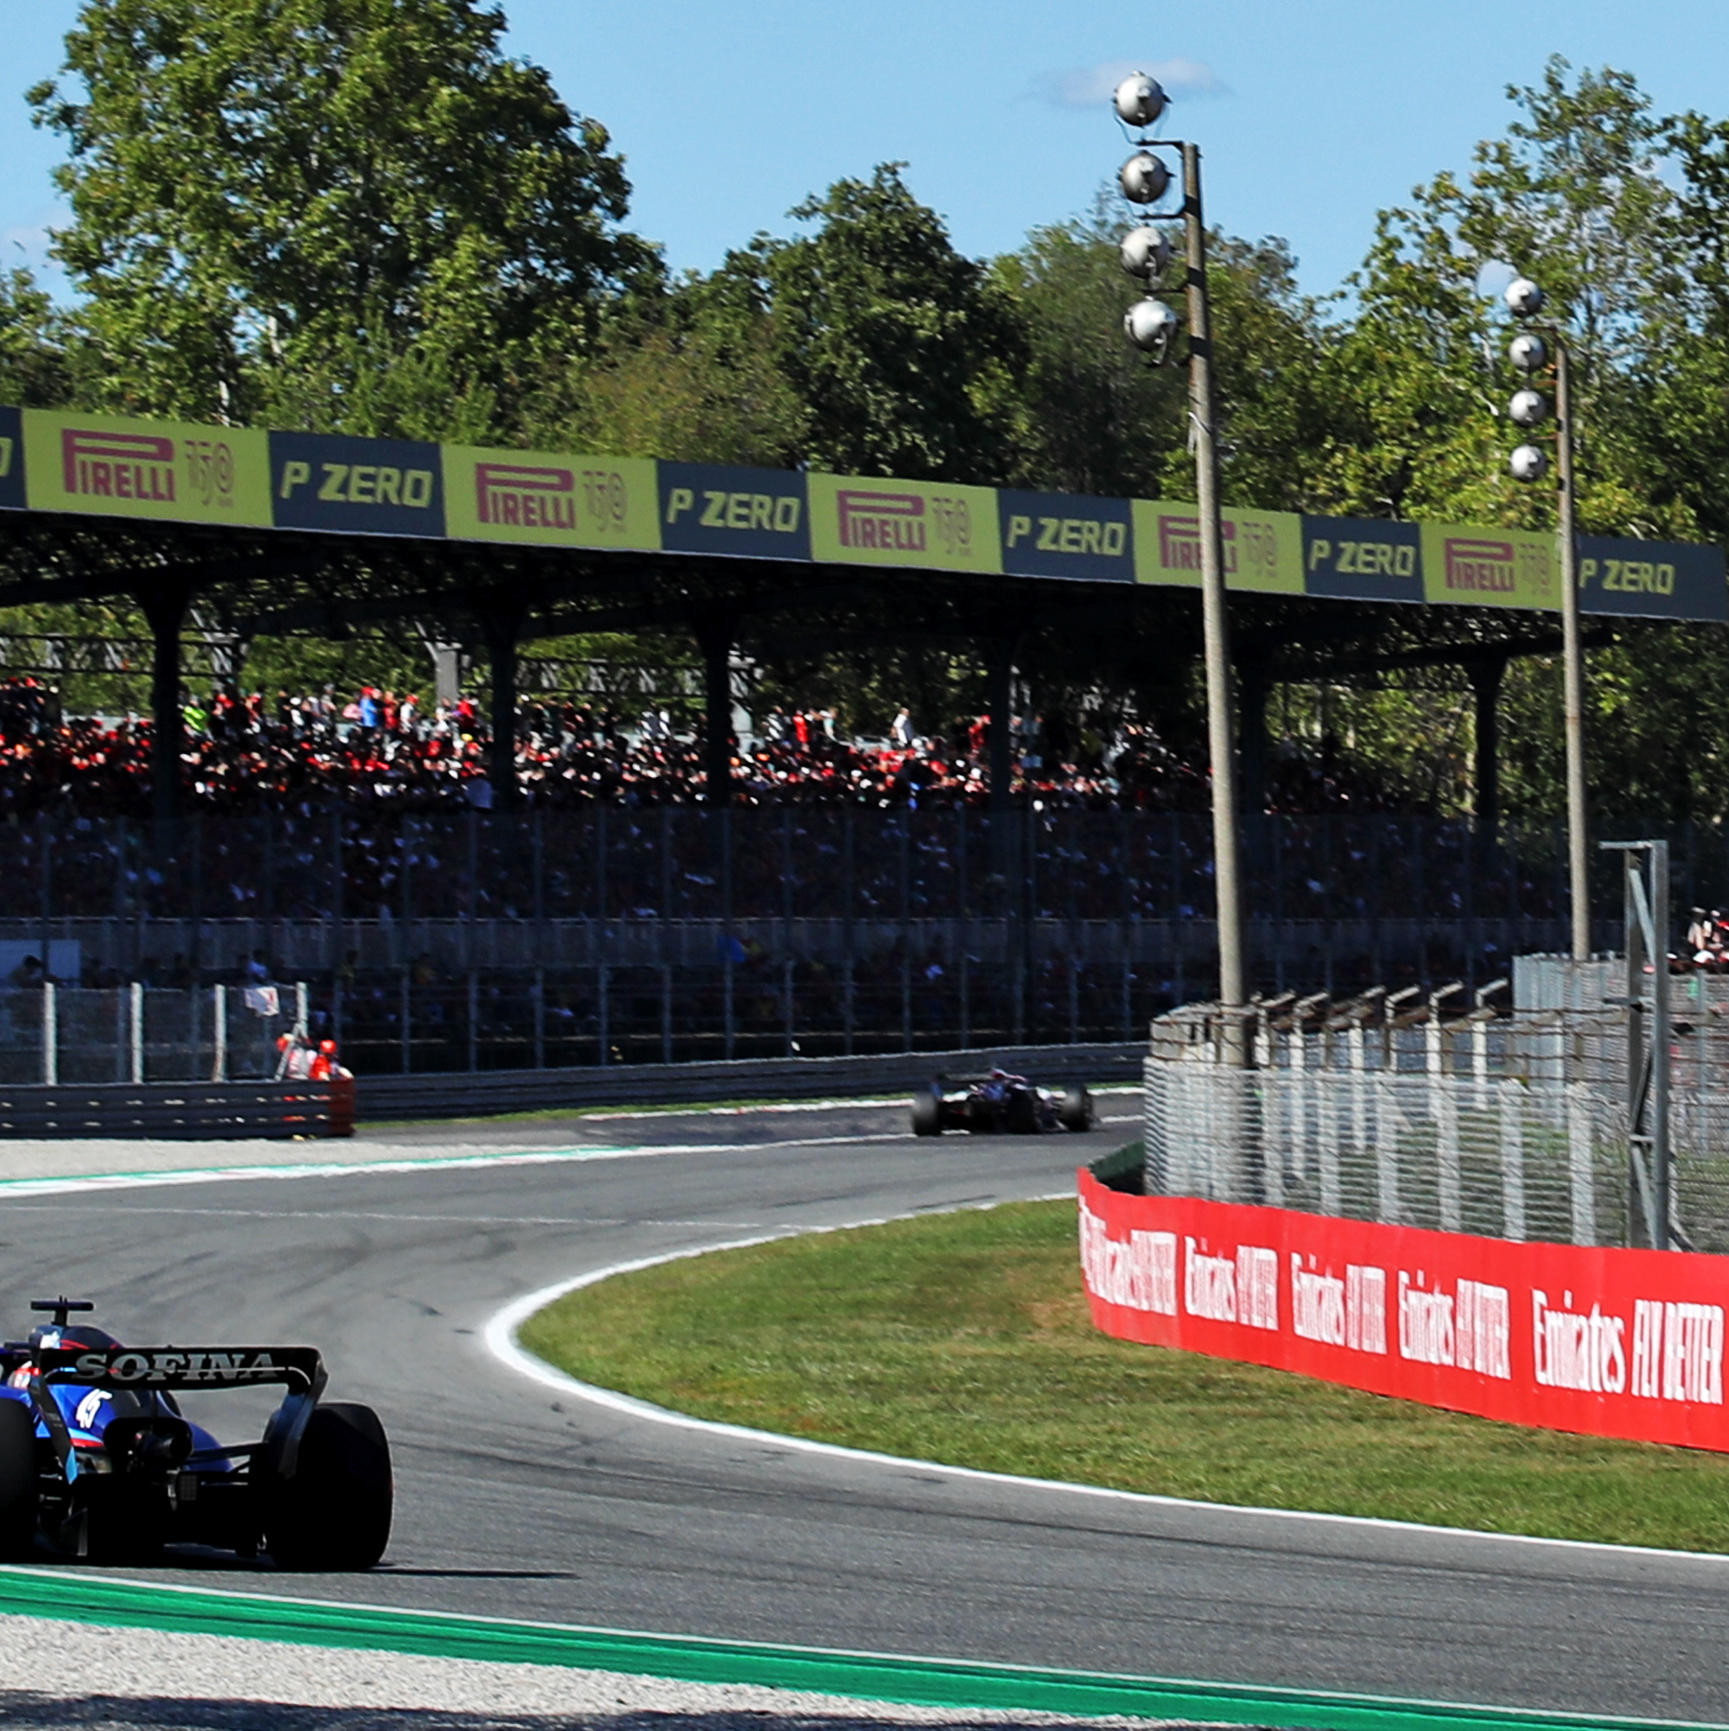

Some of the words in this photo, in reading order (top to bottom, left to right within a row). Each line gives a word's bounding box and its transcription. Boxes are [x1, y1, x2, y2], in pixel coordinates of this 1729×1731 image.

[61, 428, 177, 502] PIRELLI
[279, 460, 311, 500] P
[317, 463, 434, 509] ZERO
[475, 462, 577, 529] PIRELLI
[666, 488, 694, 525] P
[699, 489, 802, 533] ZERO
[836, 489, 927, 552] PIRELLI
[1006, 515, 1031, 549] P
[1035, 516, 1128, 557] ZERO
[1309, 539, 1332, 571] P
[1335, 541, 1417, 577] ZERO
[1445, 537, 1515, 592] PIRELLI
[1579, 557, 1597, 588] P
[1602, 558, 1675, 596] ZERO
[74, 1352, 278, 1381] SOFINA
[1531, 1288, 1626, 1394] Emirates
[1631, 1299, 1663, 1399] FLY
[1663, 1301, 1725, 1405] BETTER
